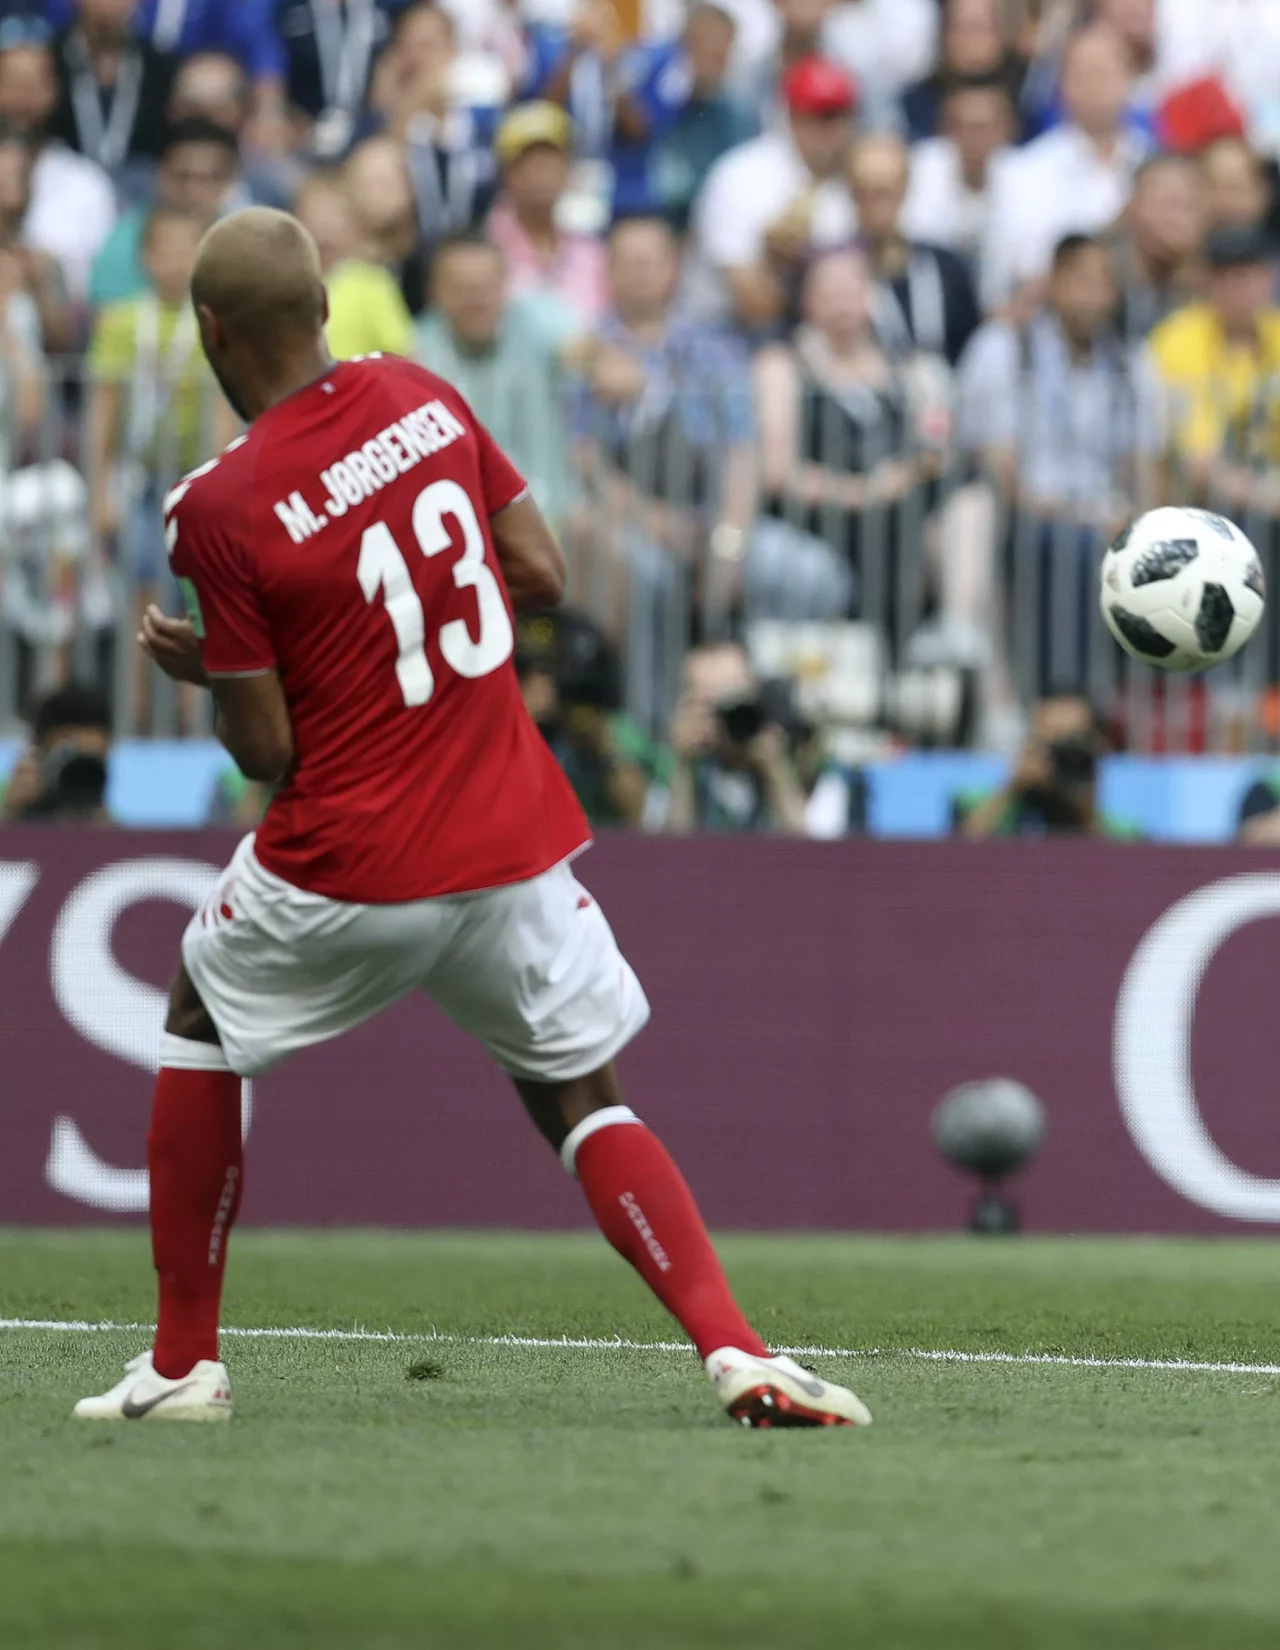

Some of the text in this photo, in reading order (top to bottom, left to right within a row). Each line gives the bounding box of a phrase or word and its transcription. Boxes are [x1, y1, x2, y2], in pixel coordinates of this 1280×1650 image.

[273, 398, 466, 544] M. JØRGENSEN
[356, 478, 515, 709] 13
